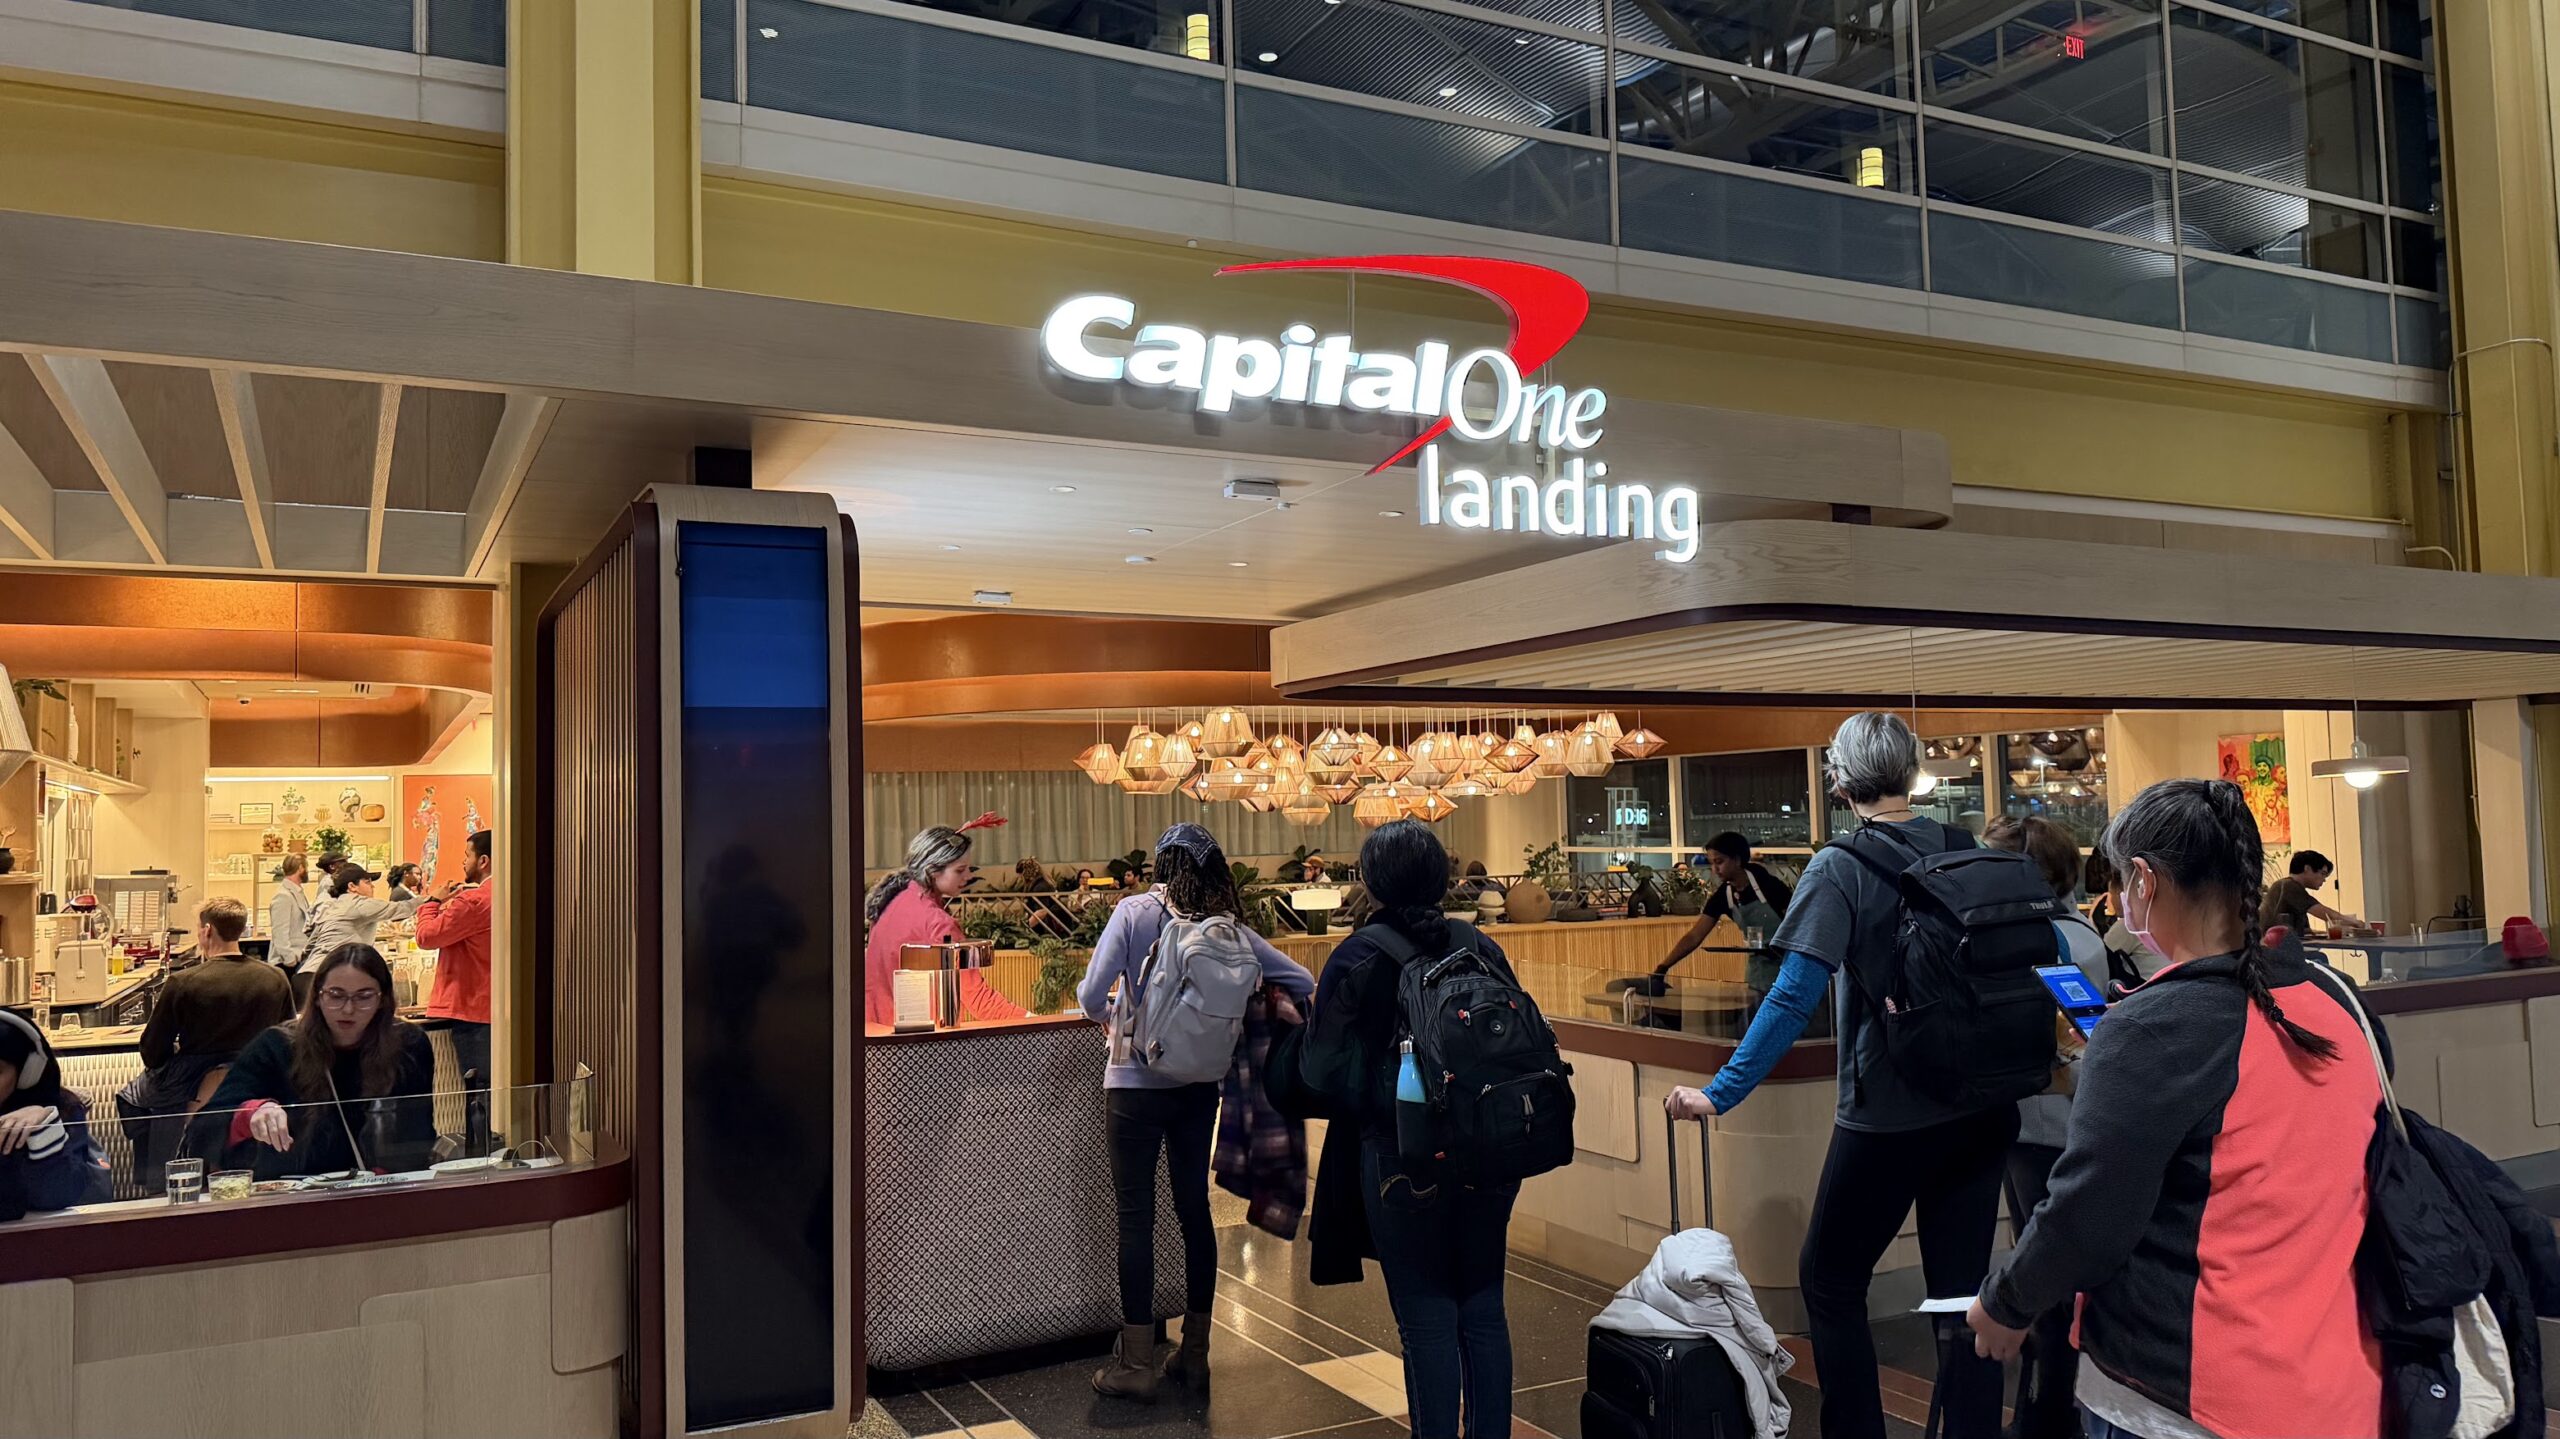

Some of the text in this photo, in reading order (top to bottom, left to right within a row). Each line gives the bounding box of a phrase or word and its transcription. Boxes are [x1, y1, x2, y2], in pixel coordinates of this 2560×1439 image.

[2065, 35, 2084, 59] EXIT
[1041, 295, 1608, 449] Capital One
[1419, 443, 1700, 563] landing
